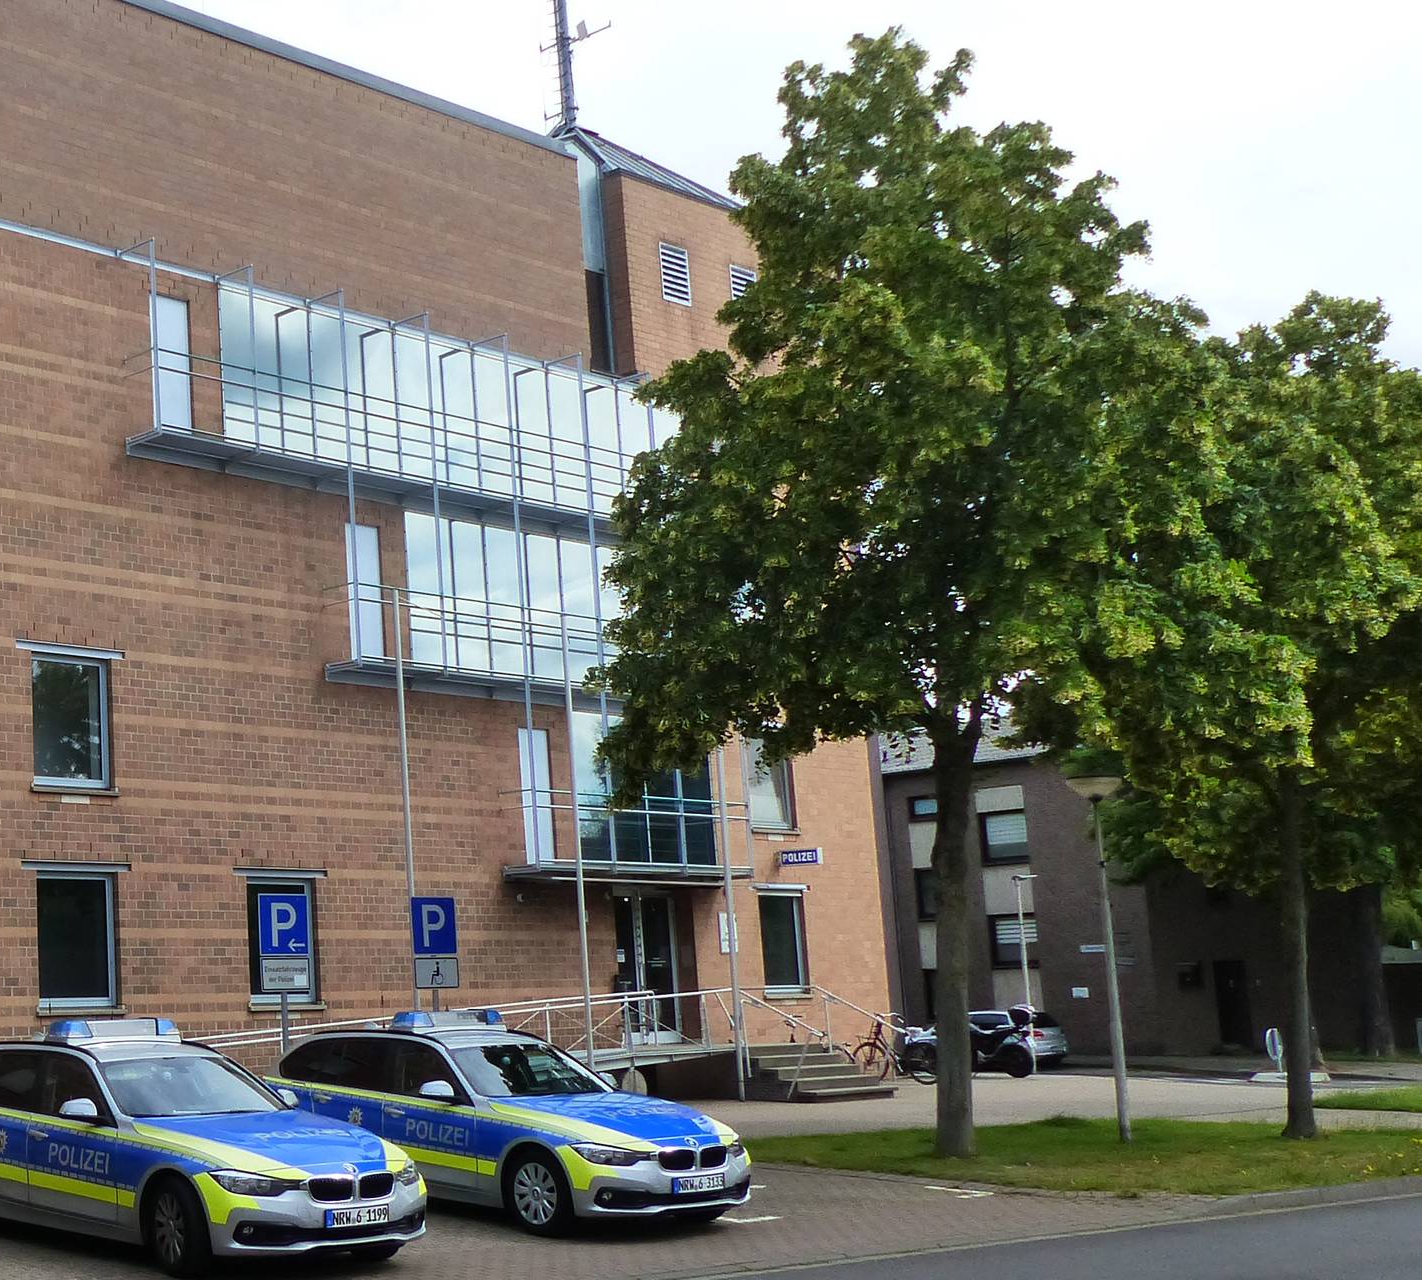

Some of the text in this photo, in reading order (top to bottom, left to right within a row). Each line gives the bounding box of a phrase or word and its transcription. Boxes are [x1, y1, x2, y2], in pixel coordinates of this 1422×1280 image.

[782, 852, 817, 863] POLIZEI
[270, 902, 297, 947] P
[421, 904, 446, 947] P
[405, 1118, 470, 1147] POLIZEI
[48, 1142, 110, 1174] POLIZEI
[679, 1178, 695, 1191] NRW
[333, 1210, 352, 1225] NRW
